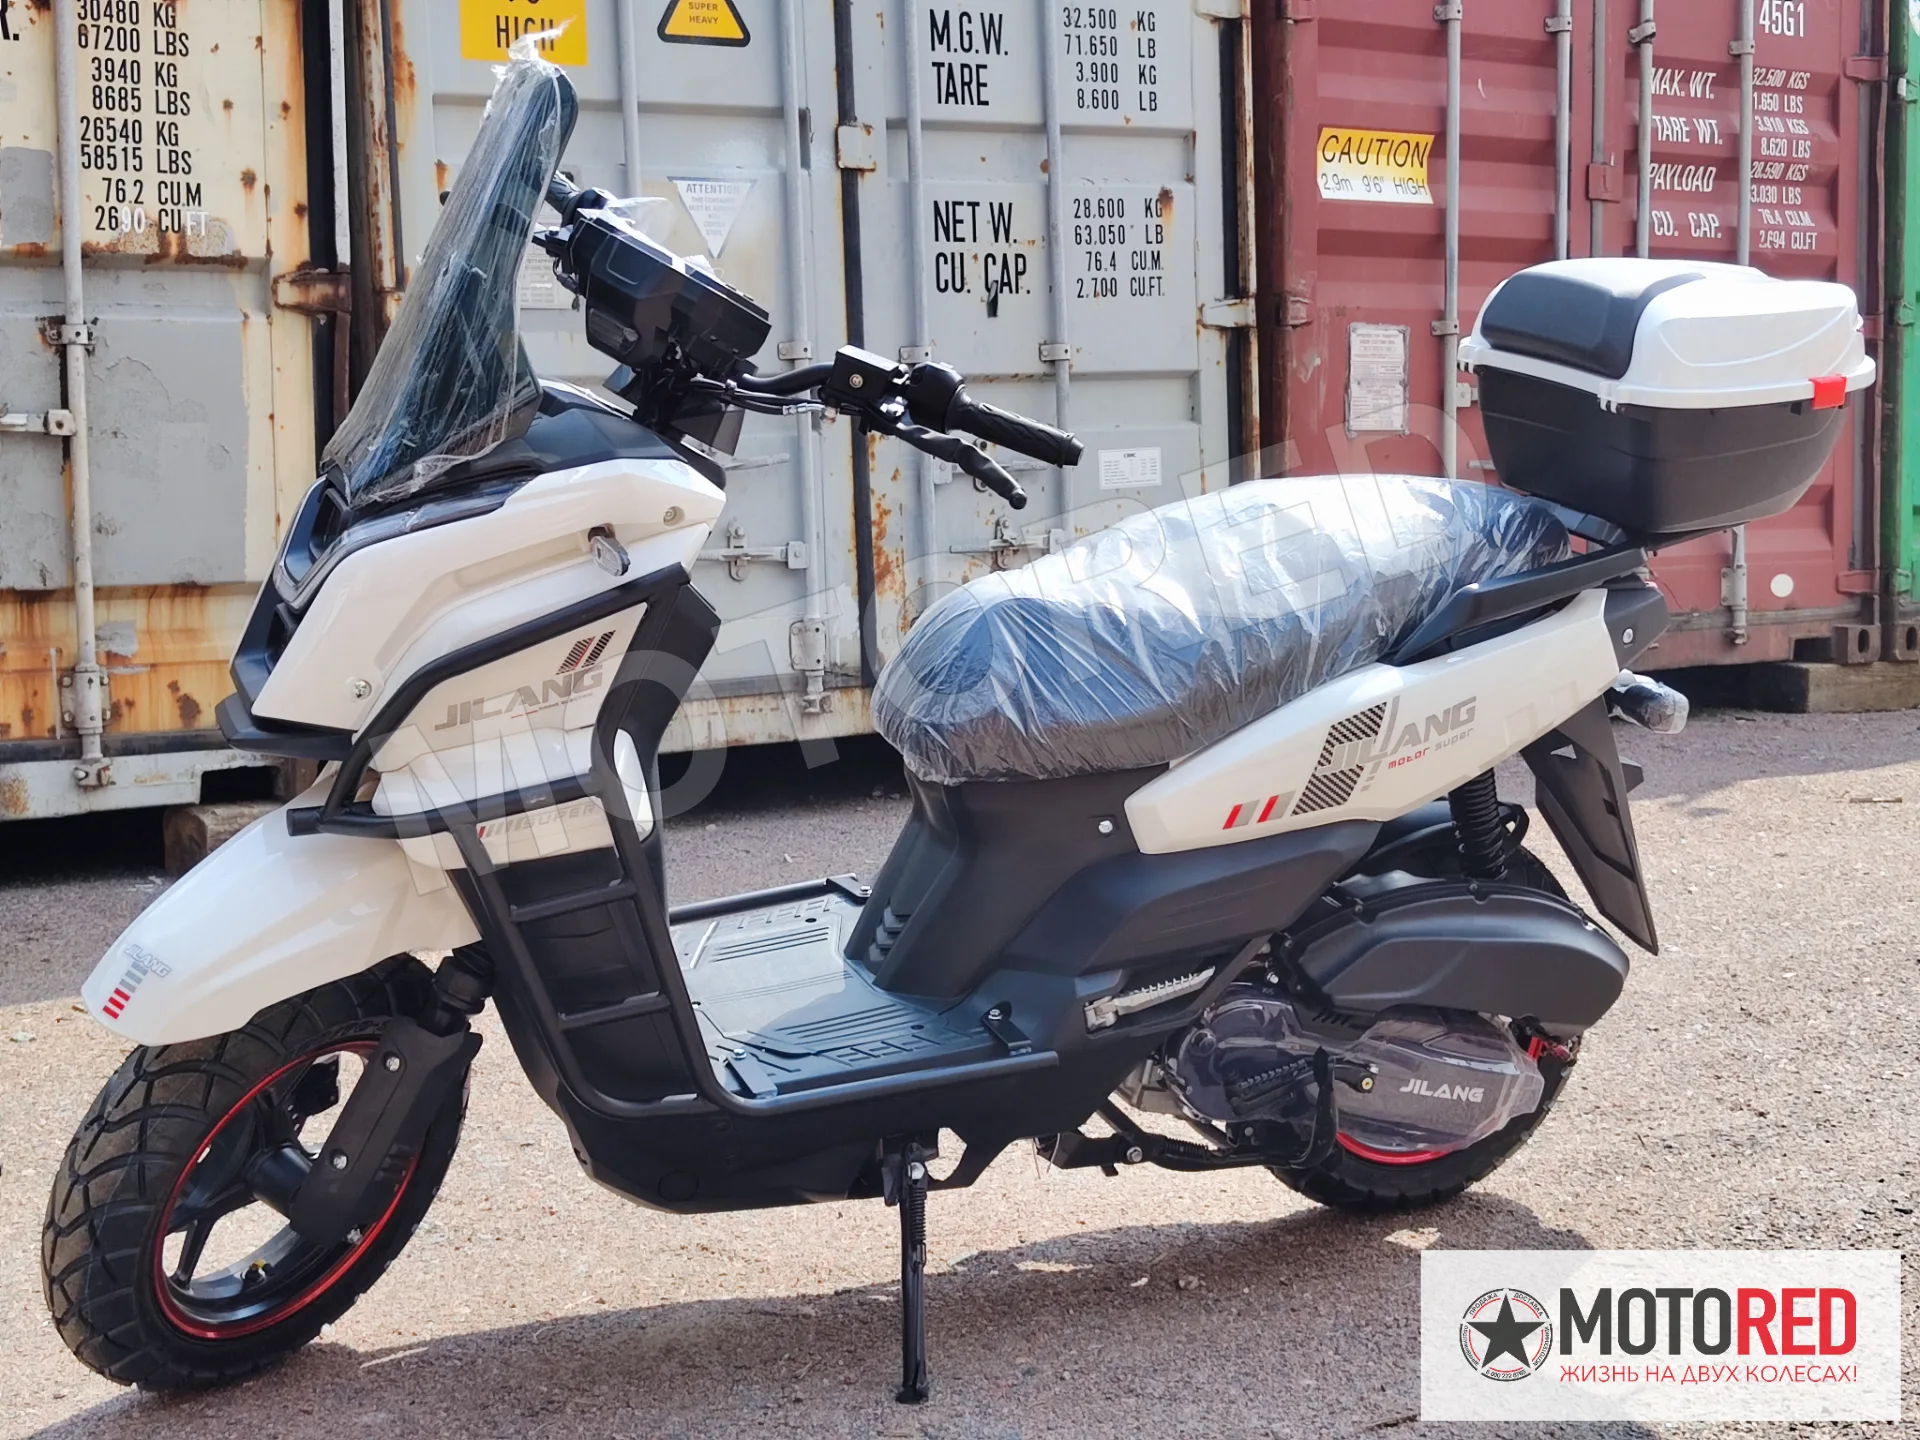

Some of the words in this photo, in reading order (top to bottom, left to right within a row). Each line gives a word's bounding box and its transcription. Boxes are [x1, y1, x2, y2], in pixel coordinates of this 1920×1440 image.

[77, 0, 140, 25] 30480
[153, 2, 176, 28] KG
[688, 1, 718, 11] SUPER
[689, 15, 718, 24] HEAVY
[1759, 1, 1805, 37] 45G1
[929, 9, 1009, 56] M.G.W.
[1137, 10, 1156, 32] KG
[78, 24, 140, 52] 67200
[153, 30, 189, 57] LBS
[1138, 37, 1156, 59] LB
[92, 57, 141, 84] 3940
[155, 62, 177, 87] KG
[932, 61, 989, 106] TARE
[1138, 64, 1157, 85] KG
[1689, 71, 1716, 99] WT.
[1787, 71, 1811, 90] KGS
[92, 85, 142, 112] 8685
[155, 89, 190, 116] LBS
[1139, 91, 1158, 112] LB
[1753, 91, 1779, 112] 1.650
[1784, 94, 1803, 114] LBS
[80, 116, 142, 144] 26540
[156, 121, 179, 147] KG
[1652, 115, 1690, 143] TARE
[1693, 118, 1723, 145] WT.
[1785, 118, 1810, 135] KGS
[81, 144, 143, 172] 58515
[156, 149, 192, 175] LBS
[1322, 135, 1428, 169] CAUTION
[1761, 137, 1788, 157] 8.620
[1792, 139, 1811, 159] LBS
[1393, 177, 1428, 196] HIGH
[1649, 163, 1717, 193] PAYLOAD
[1785, 164, 1809, 182] KGS
[102, 177, 144, 204] 76.2
[157, 181, 202, 207] CU.M
[685, 183, 741, 195] ATTENTION
[1750, 184, 1777, 204] 3.030
[1782, 186, 1801, 205] LBS
[95, 205, 146, 234] 2690
[933, 200, 980, 243] NET
[989, 202, 1018, 244] W.
[1144, 198, 1163, 218] KG
[1145, 224, 1164, 245] LB
[1652, 210, 1679, 237] CU.
[1688, 212, 1722, 238] CAP.
[935, 252, 971, 293] CU.
[983, 252, 1031, 294] CAP.
[1085, 251, 1117, 272] 76.4
[434, 663, 603, 731] JILANG
[1316, 695, 1477, 776] JILANG
[1388, 746, 1430, 769] motor
[1434, 727, 1475, 751] super
[523, 803, 596, 830] SUPER
[123, 943, 172, 978] JILANG
[1399, 1078, 1485, 1103] JILANG
